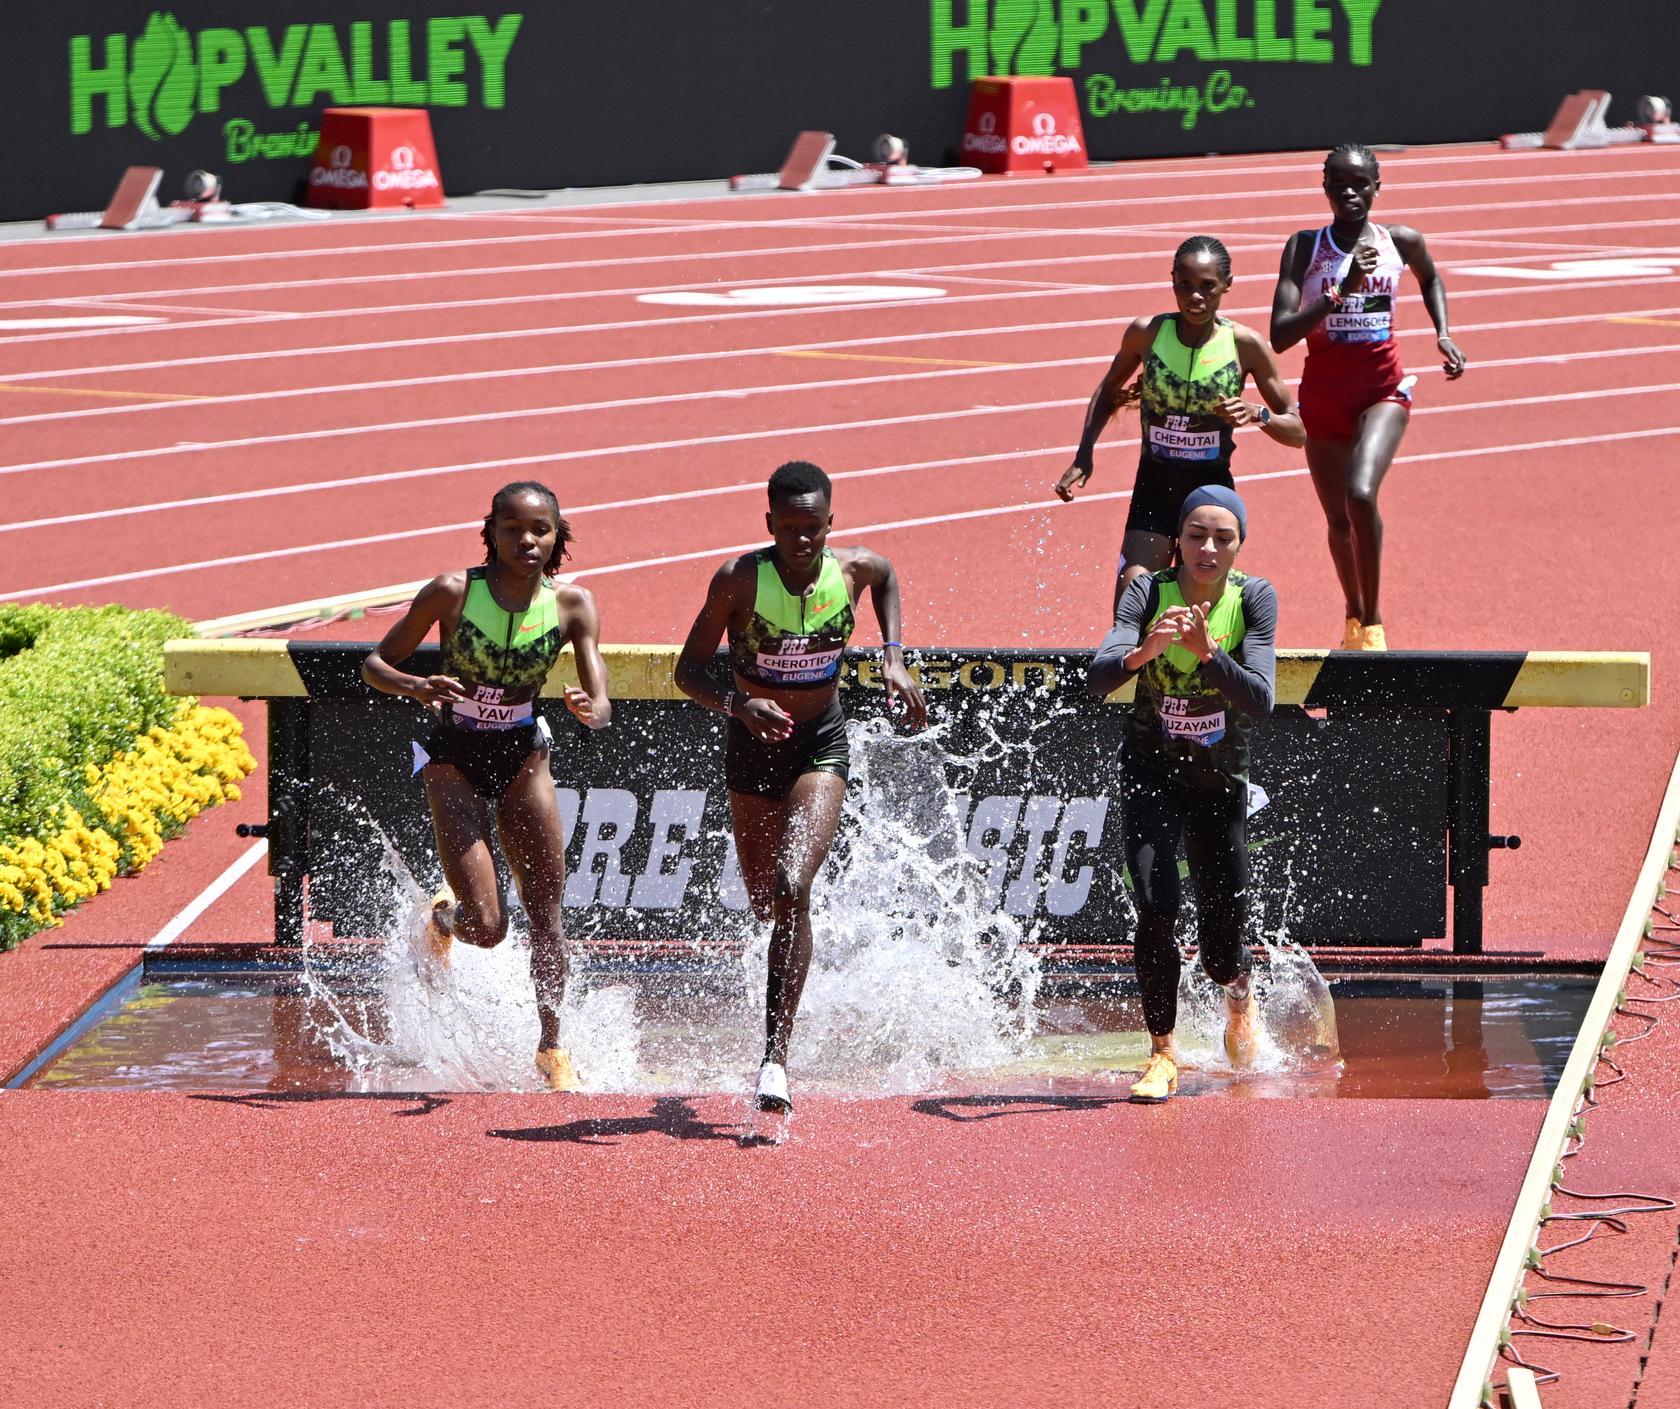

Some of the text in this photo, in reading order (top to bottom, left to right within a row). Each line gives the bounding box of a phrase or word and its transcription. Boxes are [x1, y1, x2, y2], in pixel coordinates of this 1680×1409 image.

[1085, 69, 1255, 130] Brewing Co.
[962, 133, 1008, 154] OMEGA
[1010, 135, 1082, 155] OMEGA
[309, 166, 368, 188] OMEGA
[372, 169, 439, 190] OMEGA
[1321, 277, 1392, 293] AAMA
[1341, 297, 1366, 313] PRE
[1348, 332, 1381, 341] EUGENE
[1163, 415, 1190, 431] PRE
[1154, 431, 1215, 446] CHEMUTAI
[1169, 449, 1206, 458] EUGENE
[777, 638, 810, 655] PRE
[763, 654, 836, 669] CHEROTICH
[782, 670, 825, 681] EUGENE
[473, 685, 505, 705] PRE
[477, 705, 514, 721] YAVI
[1162, 696, 1190, 716] PRE
[1166, 717, 1220, 731] UZAYANI
